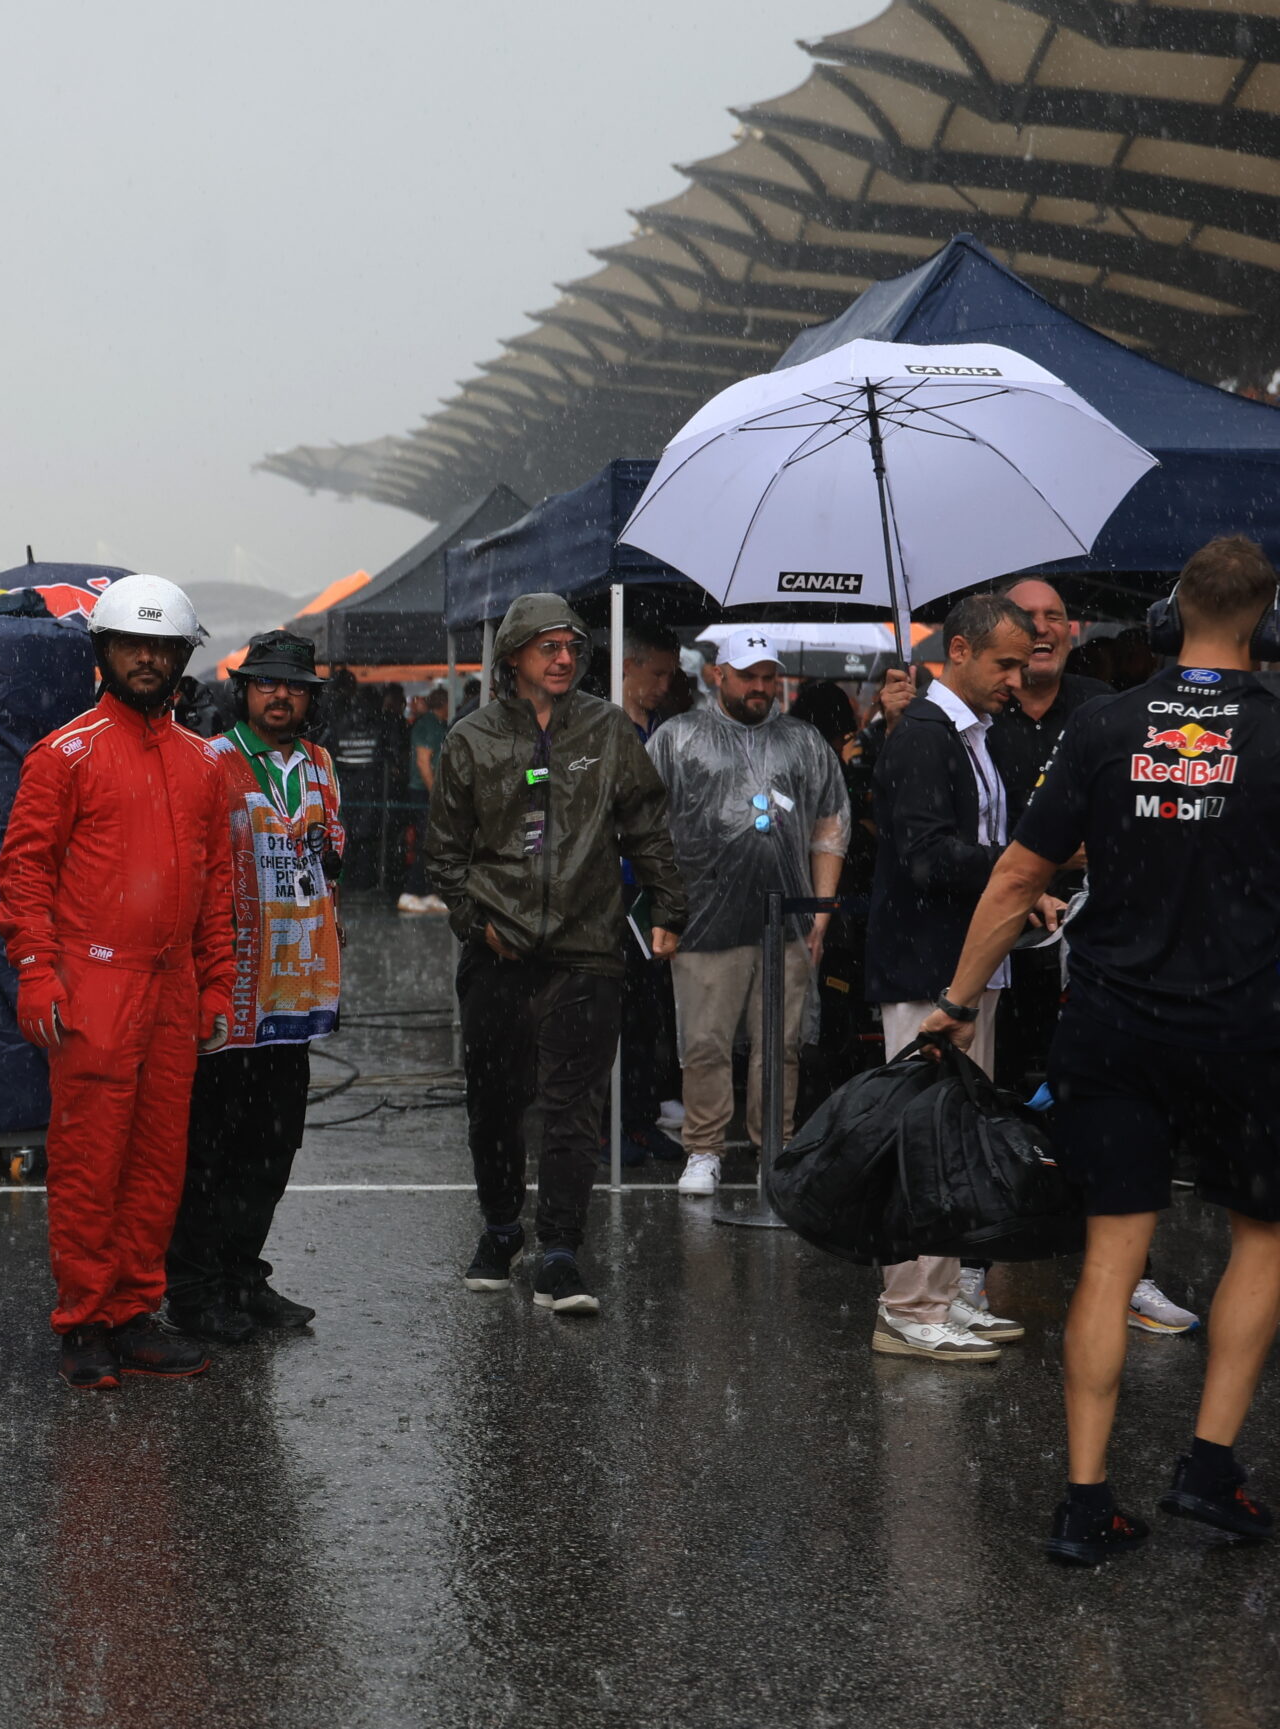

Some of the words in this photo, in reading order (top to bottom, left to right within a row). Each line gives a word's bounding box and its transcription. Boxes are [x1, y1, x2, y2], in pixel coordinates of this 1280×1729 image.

[908, 365, 998, 376] CANAL+
[781, 574, 859, 591] CANAL+
[137, 608, 162, 620] OMP
[1147, 701, 1240, 719] ORACLE
[62, 738, 84, 756] OMP
[1135, 794, 1204, 821] Mobi
[275, 883, 319, 898] MAH.
[270, 916, 323, 960] PT
[89, 946, 113, 960] OMP
[231, 927, 252, 1037] BAHRAIN
